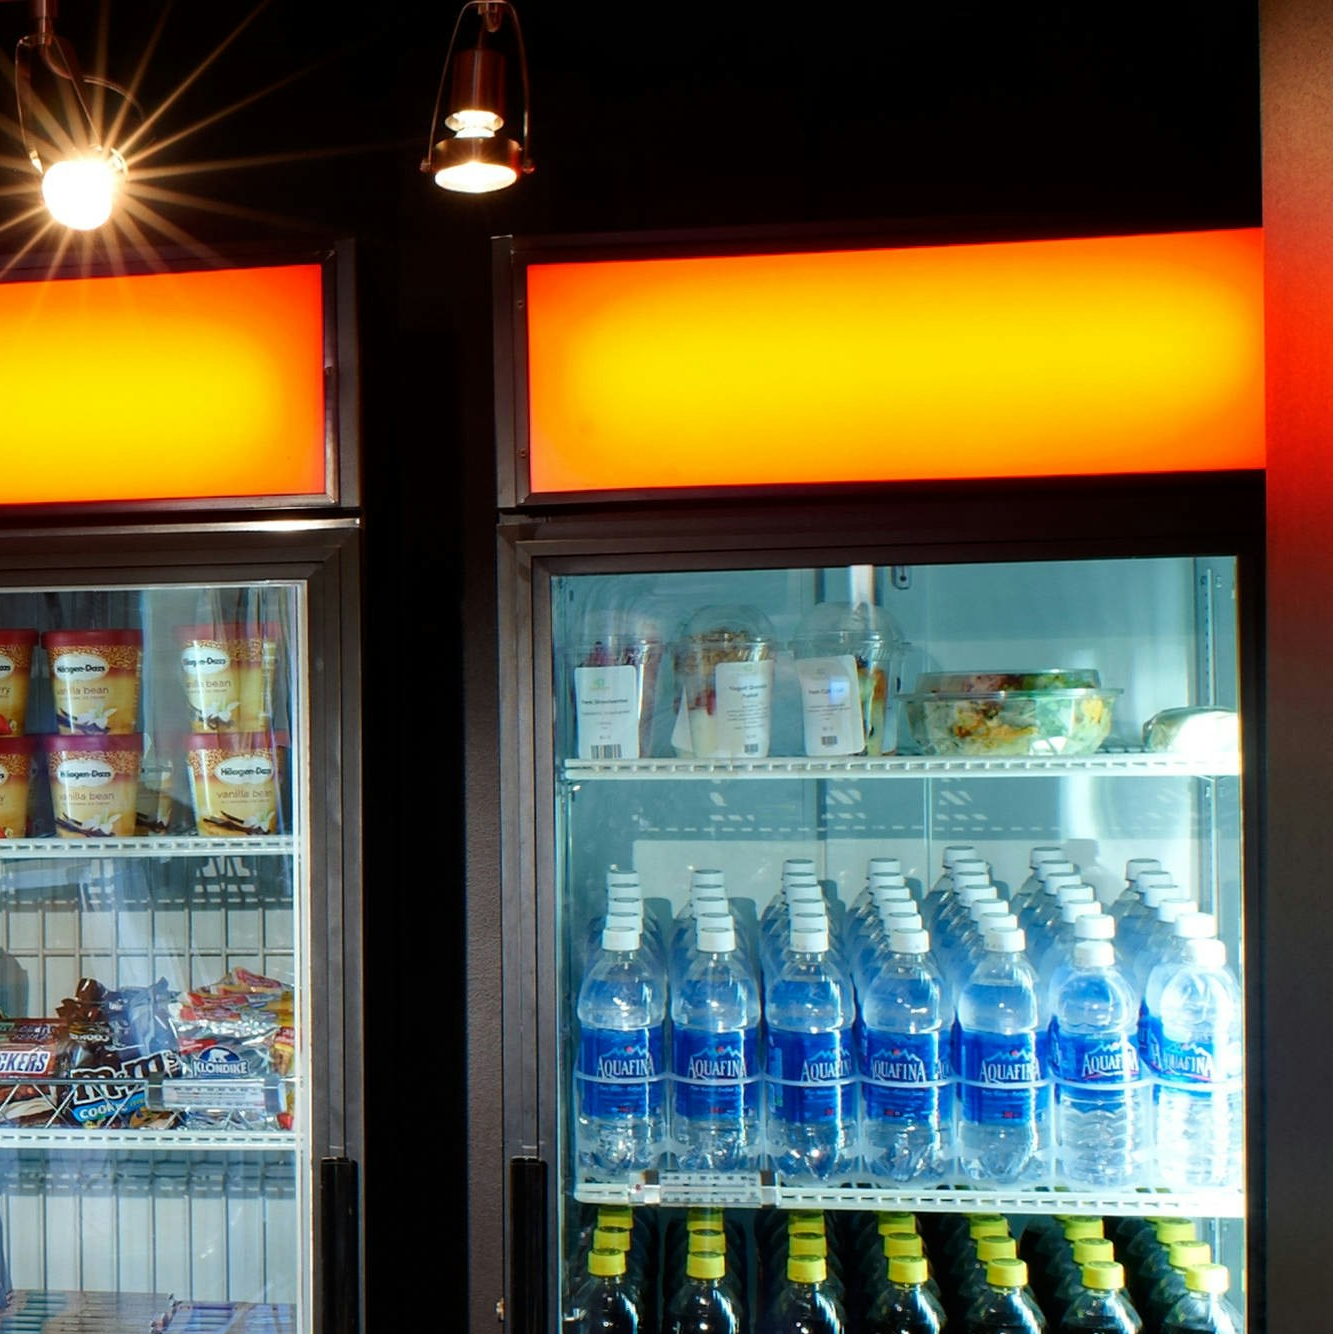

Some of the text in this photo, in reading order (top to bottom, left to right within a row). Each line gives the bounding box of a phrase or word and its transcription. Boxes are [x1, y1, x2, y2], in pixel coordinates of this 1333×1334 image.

[83, 685, 110, 695] bean
[87, 791, 115, 800] bean
[216, 789, 250, 799] vanilla
[193, 1060, 249, 1075] KLONDIKE
[687, 1056, 748, 1080] AQUAFINA
[870, 1057, 927, 1083] AQUAFINA
